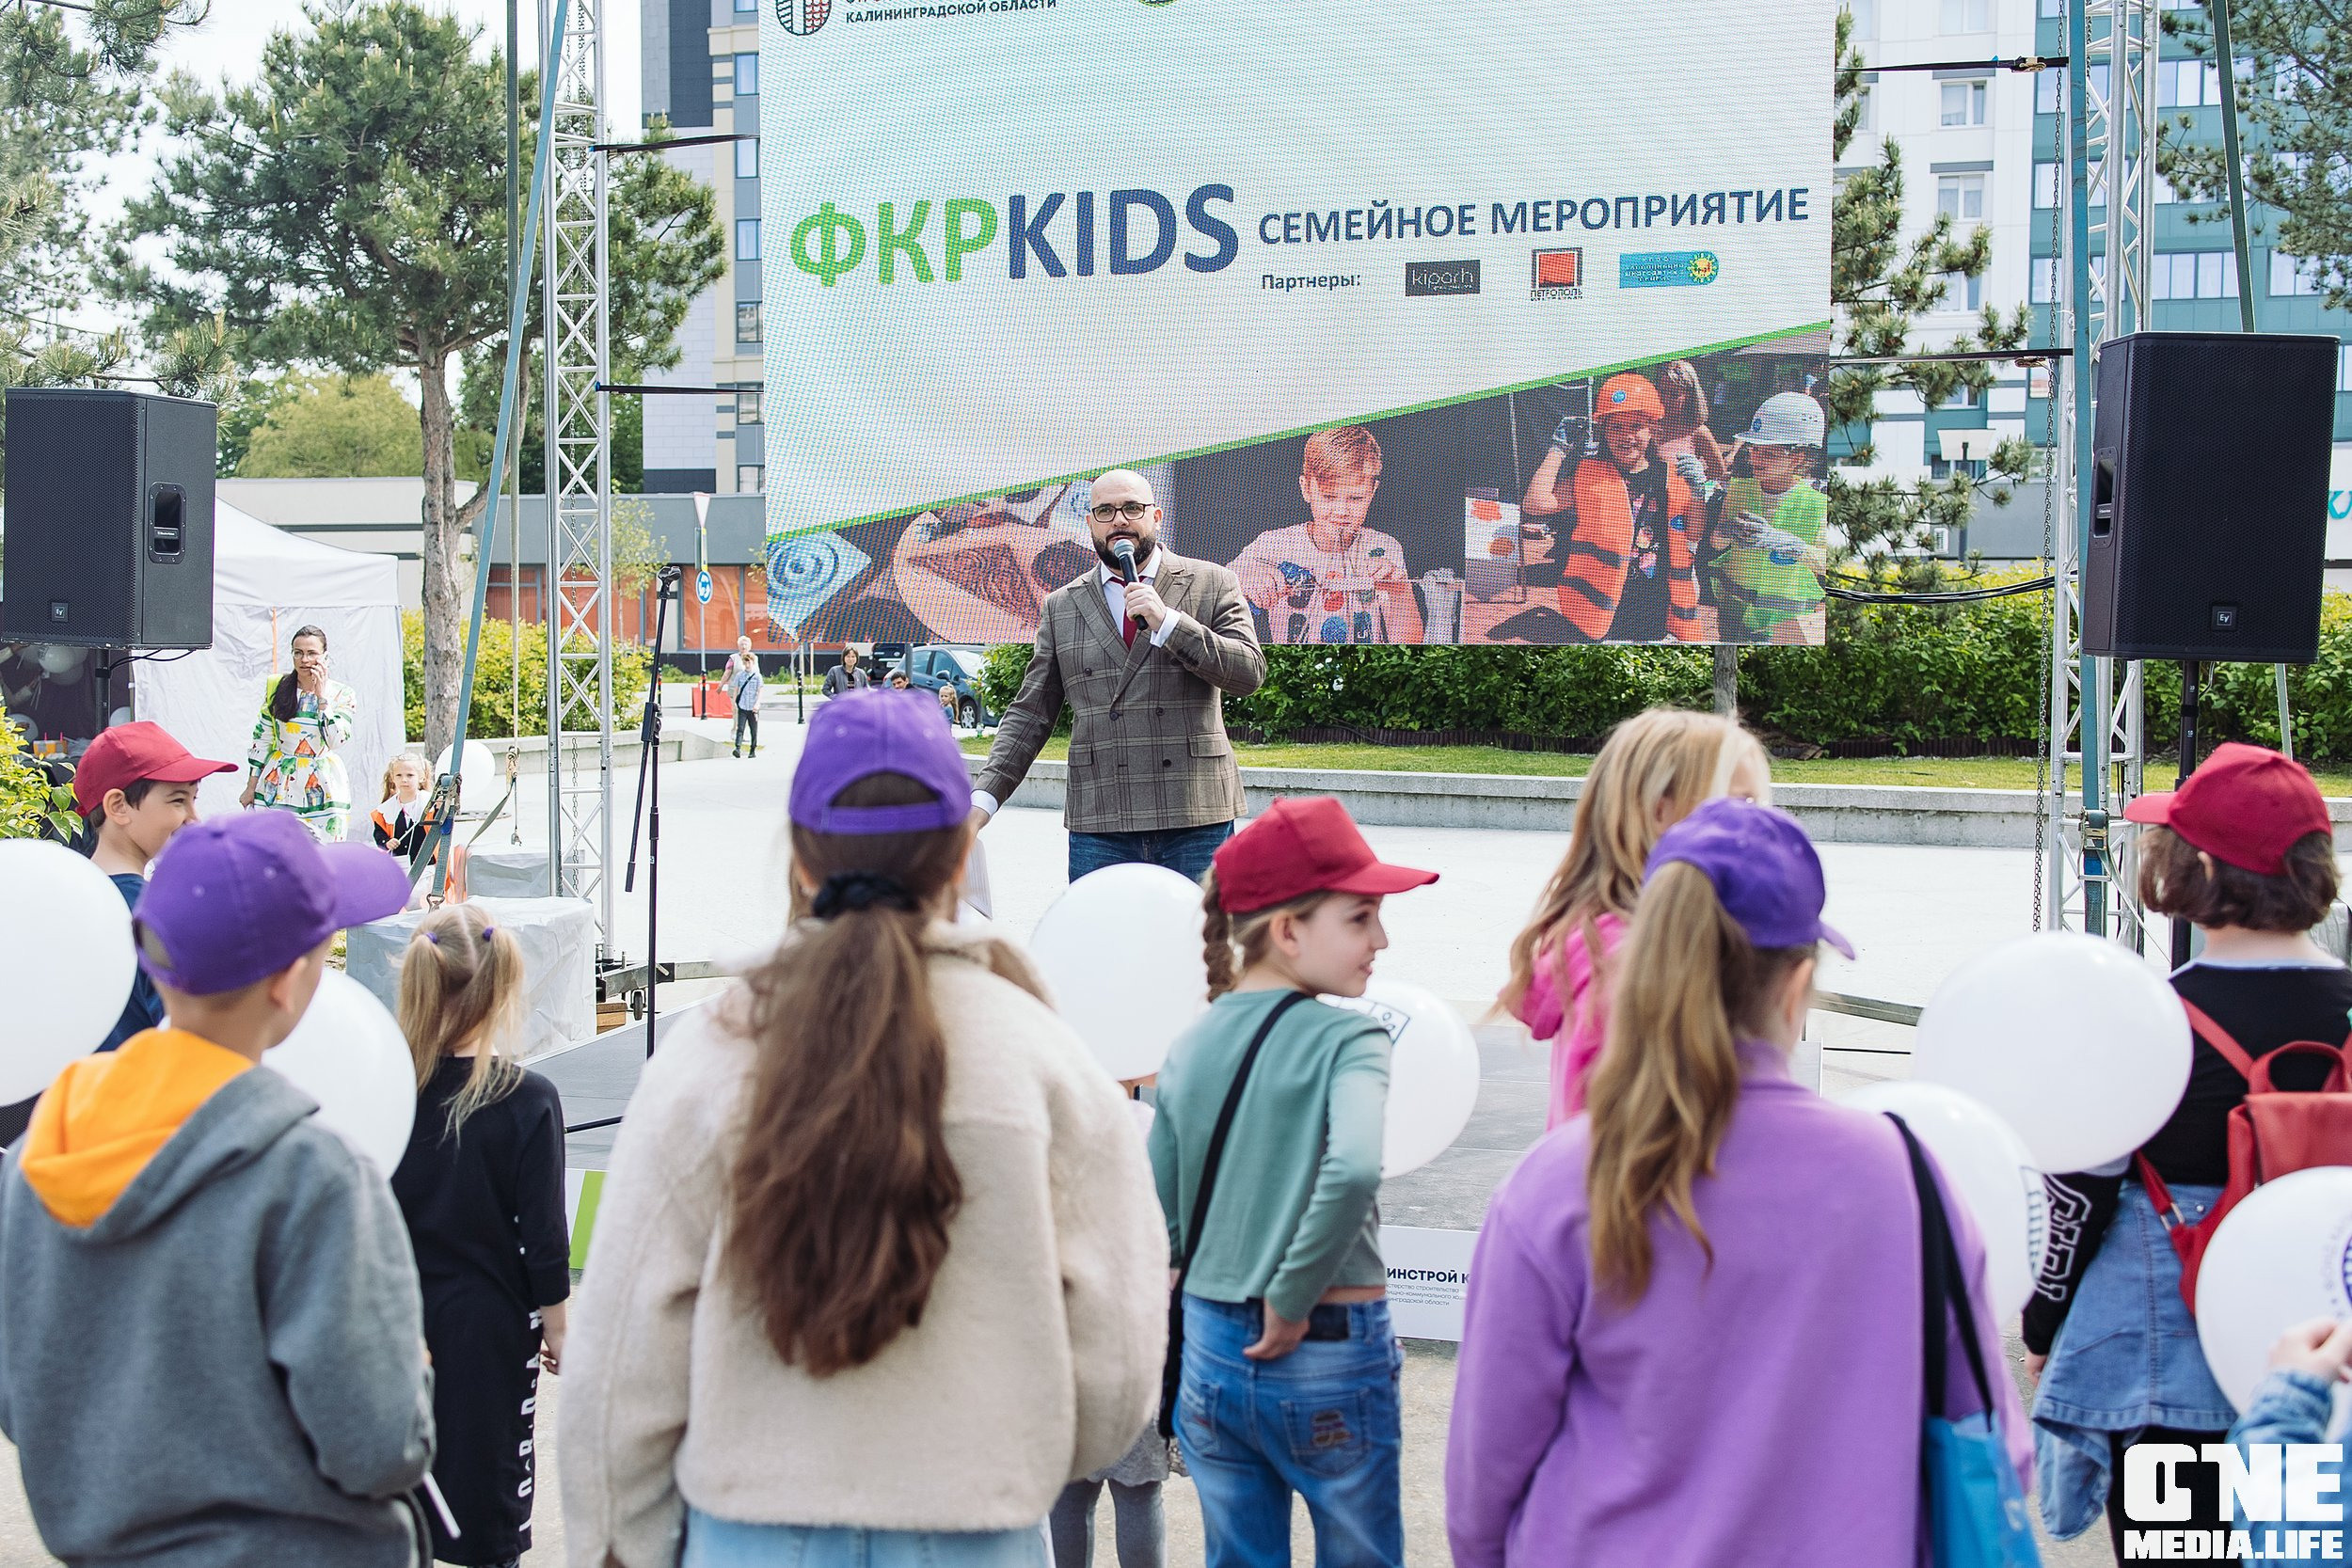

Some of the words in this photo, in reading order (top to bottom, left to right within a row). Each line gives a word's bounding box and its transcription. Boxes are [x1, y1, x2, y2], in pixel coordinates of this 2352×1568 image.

[846, 0, 986, 24] КАЛИНИНГРАДСКОЙ
[989, 0, 1057, 12] ОБЛАСТИ
[1258, 198, 1476, 245] СЕМЕЙНОЕ
[1491, 188, 1809, 235] МЕРОПРИЯТИЕ
[1262, 274, 1360, 293] Партнеры:
[1387, 1268, 1457, 1283] ИНСТРОЙ
